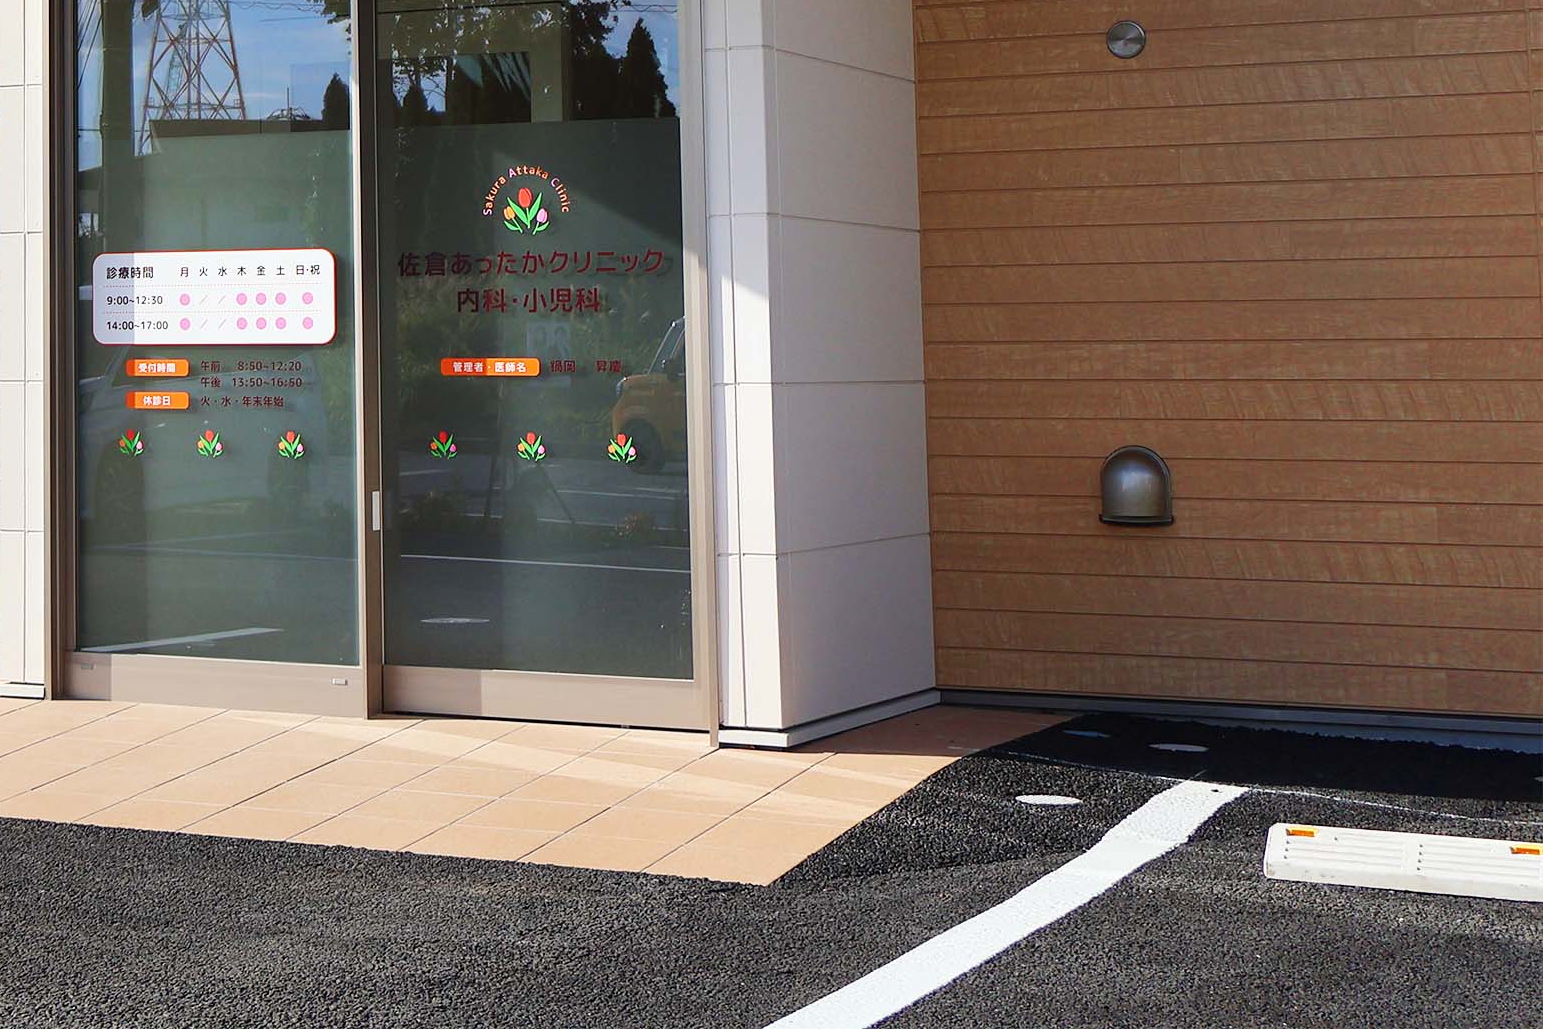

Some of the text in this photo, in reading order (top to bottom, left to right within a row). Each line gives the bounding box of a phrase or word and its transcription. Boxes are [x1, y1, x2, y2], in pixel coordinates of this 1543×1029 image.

[483, 165, 570, 216] Sakura Attaka Clinic
[397, 249, 663, 277] 佐倉あったかクリニック
[106, 266, 154, 279] 診療時間
[180, 266, 189, 277] 月
[199, 266, 208, 277] 火
[218, 266, 227, 276] 水
[237, 265, 247, 276] 木
[256, 265, 266, 276] 金
[276, 265, 286, 276] 土
[458, 287, 601, 313] 内科・小児科
[138, 362, 176, 373] 受付時間
[201, 361, 221, 372] 午前
[201, 377, 221, 388] 午後
[142, 395, 172, 406] 休診日
